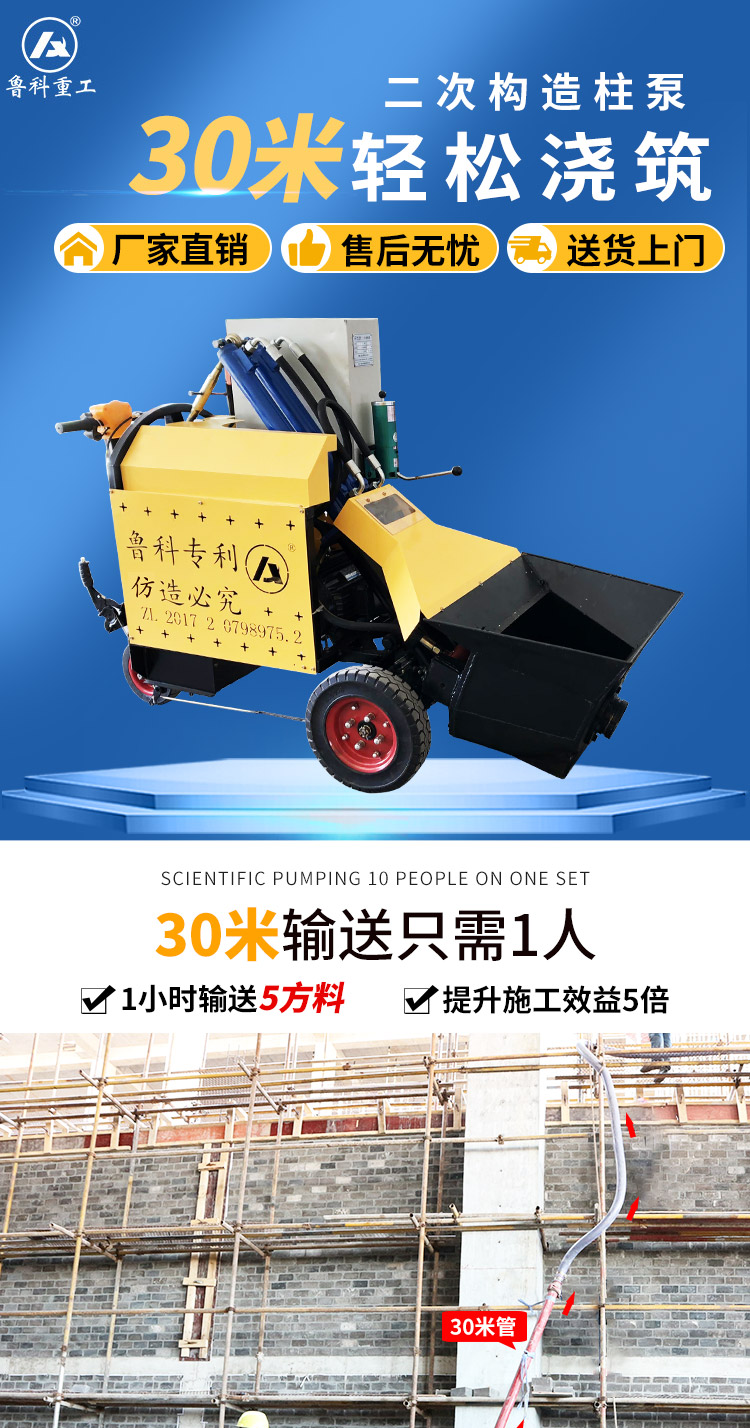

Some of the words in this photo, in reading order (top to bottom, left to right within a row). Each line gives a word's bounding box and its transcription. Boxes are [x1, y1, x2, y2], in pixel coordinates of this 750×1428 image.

[126, 530, 238, 572] 鲁科专利
[131, 576, 242, 615] 仿造必究
[165, 610, 197, 628] 2017
